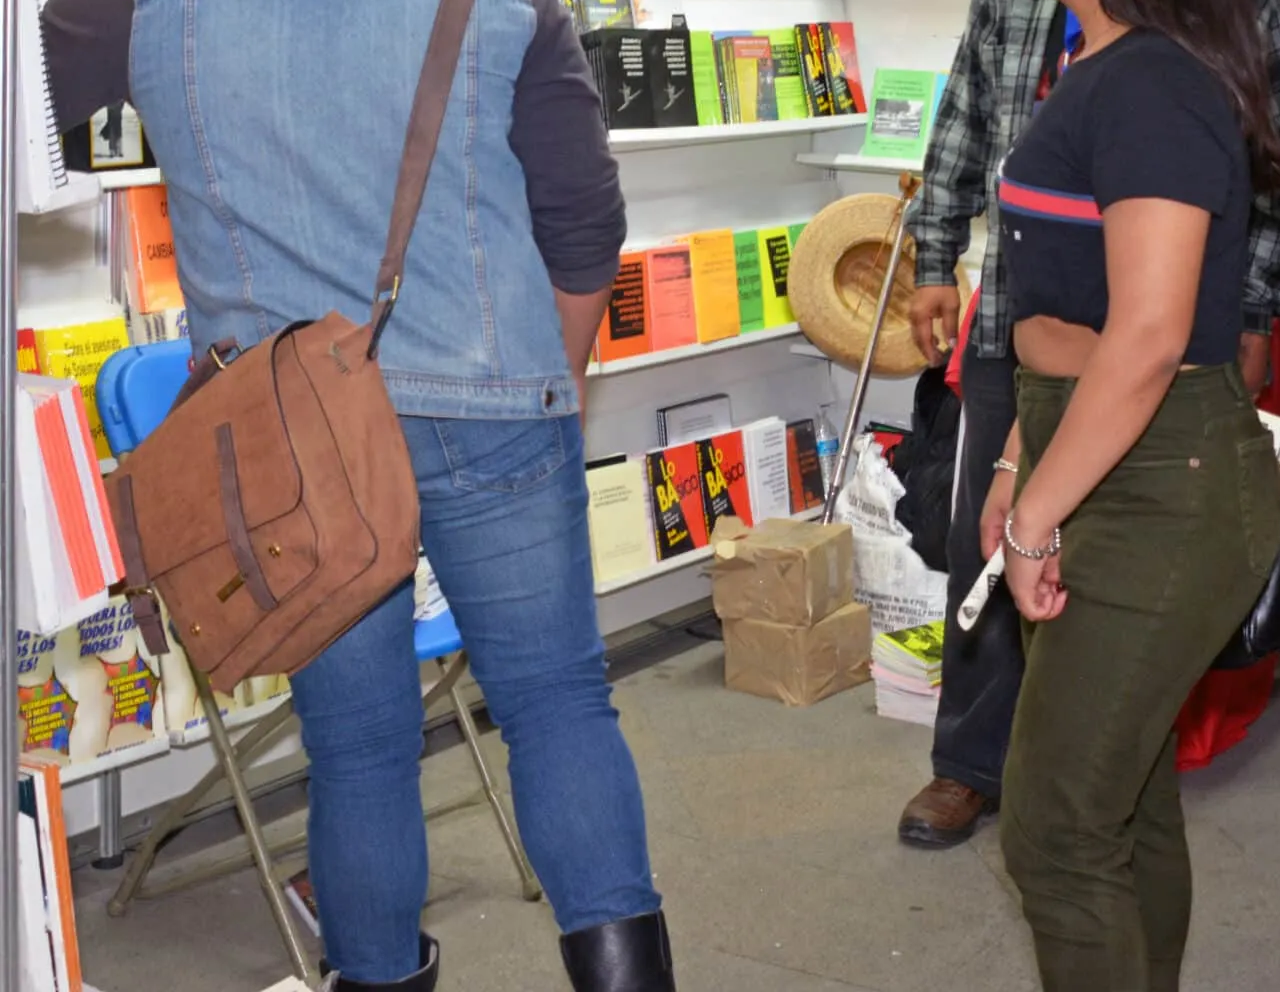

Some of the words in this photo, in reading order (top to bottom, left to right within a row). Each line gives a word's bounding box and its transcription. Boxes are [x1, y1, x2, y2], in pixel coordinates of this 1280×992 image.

[79, 622, 114, 642] TODOS
[32, 637, 57, 654] LOS
[80, 635, 124, 657] DIOSES!
